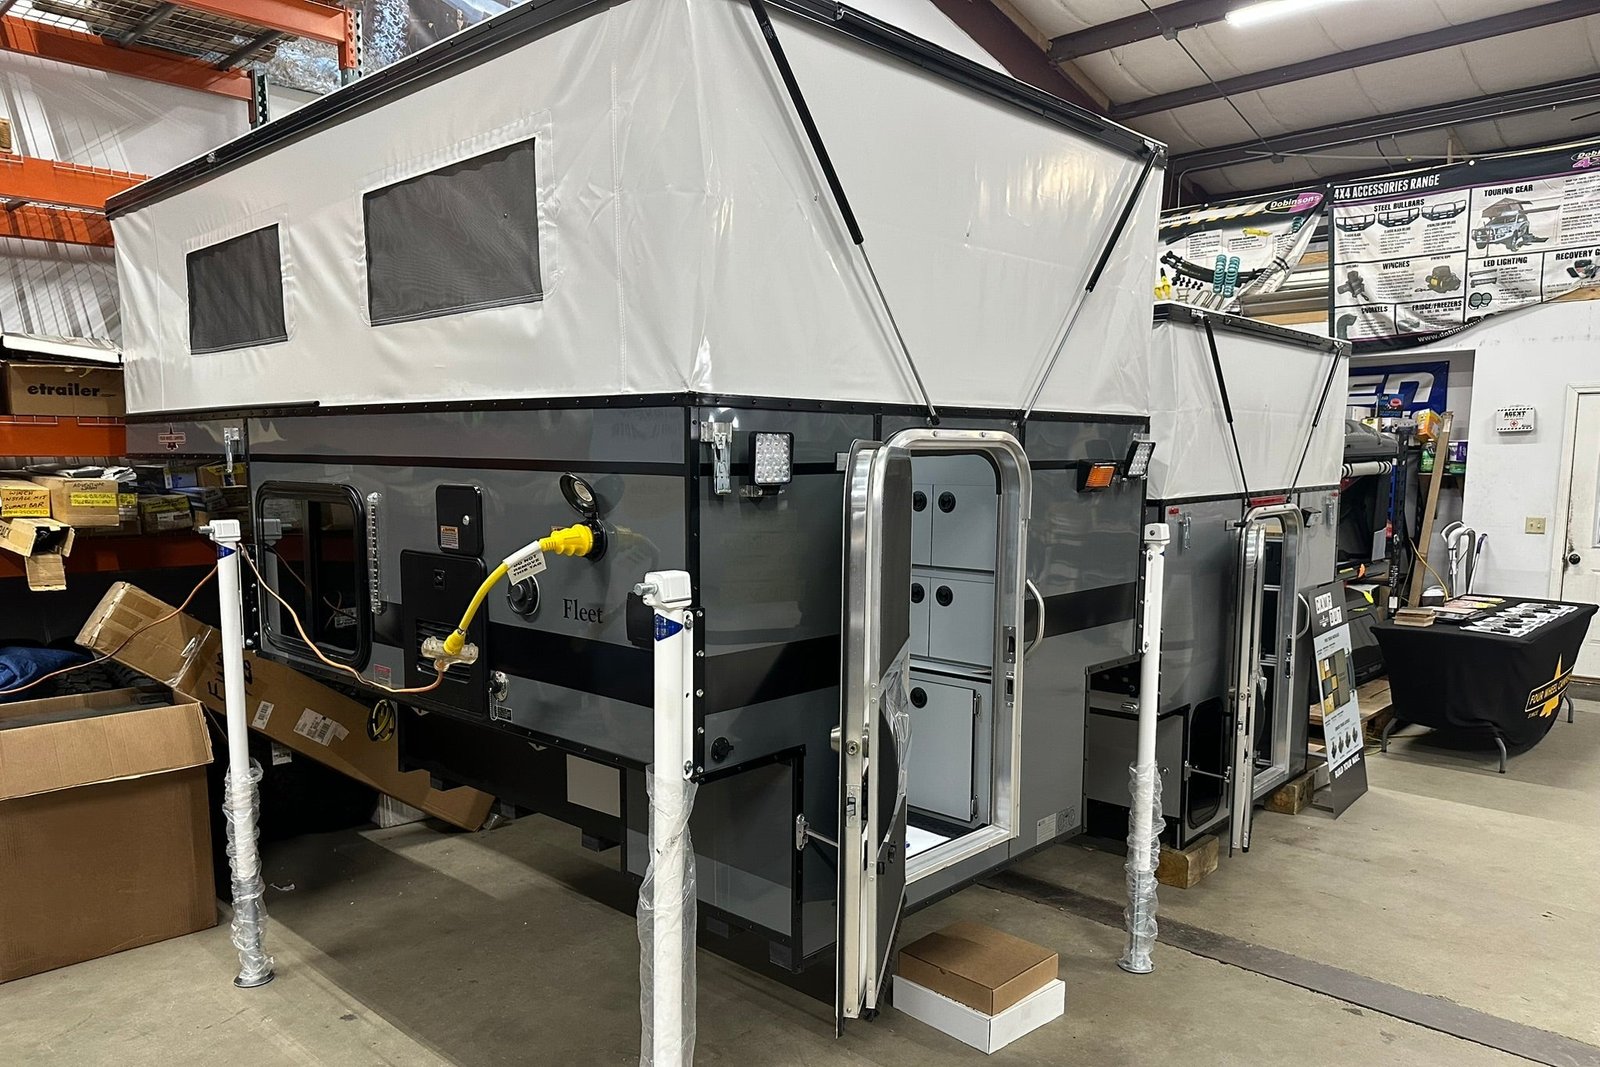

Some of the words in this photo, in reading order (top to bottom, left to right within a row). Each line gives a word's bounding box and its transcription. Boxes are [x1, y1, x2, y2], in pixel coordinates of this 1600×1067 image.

[1334, 187, 1351, 199] 4X4
[1352, 179, 1409, 198] ACCESSORIES
[1410, 174, 1440, 190] RANGE
[1484, 186, 1514, 197] TOURING
[1515, 184, 1534, 194] GEAR
[1270, 194, 1322, 209] Dobinsons
[1374, 204, 1391, 212] STEEL
[1393, 199, 1425, 210] BULLBARS
[1160, 216, 1191, 225] omponents
[1555, 249, 1593, 260] RECOVERY
[1382, 260, 1410, 270] WINCHES
[1483, 259, 1495, 267] LED
[1497, 257, 1528, 266] LIGHTING
[1412, 300, 1462, 312] FRIDGE/FREEZERS
[1504, 410, 1526, 418] AGENT
[29, 501, 45, 509] BAR
[524, 554, 537, 562] NOT
[513, 558, 540, 572] REMOVE
[513, 568, 528, 576] THIS
[530, 561, 542, 569] TAG
[563, 598, 604, 624] Fleet
